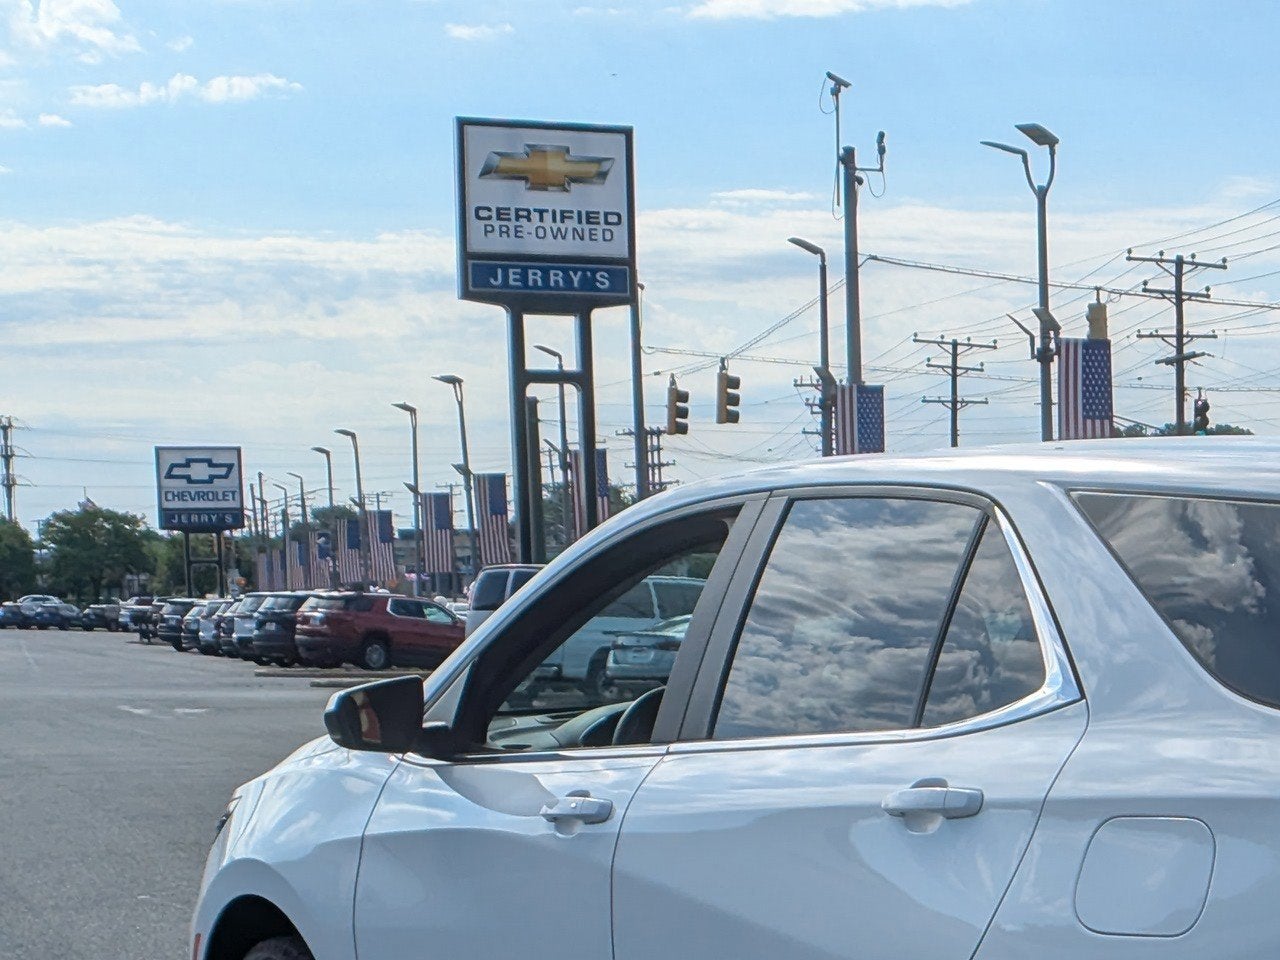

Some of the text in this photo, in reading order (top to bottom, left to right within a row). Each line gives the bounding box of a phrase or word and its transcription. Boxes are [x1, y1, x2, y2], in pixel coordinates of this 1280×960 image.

[474, 205, 622, 226] CERTIFIED
[483, 223, 614, 243] PRE-OWNED
[489, 268, 610, 289] JERRY'S
[164, 490, 237, 502] CHEVROLET
[171, 513, 233, 523] JERRY'S
